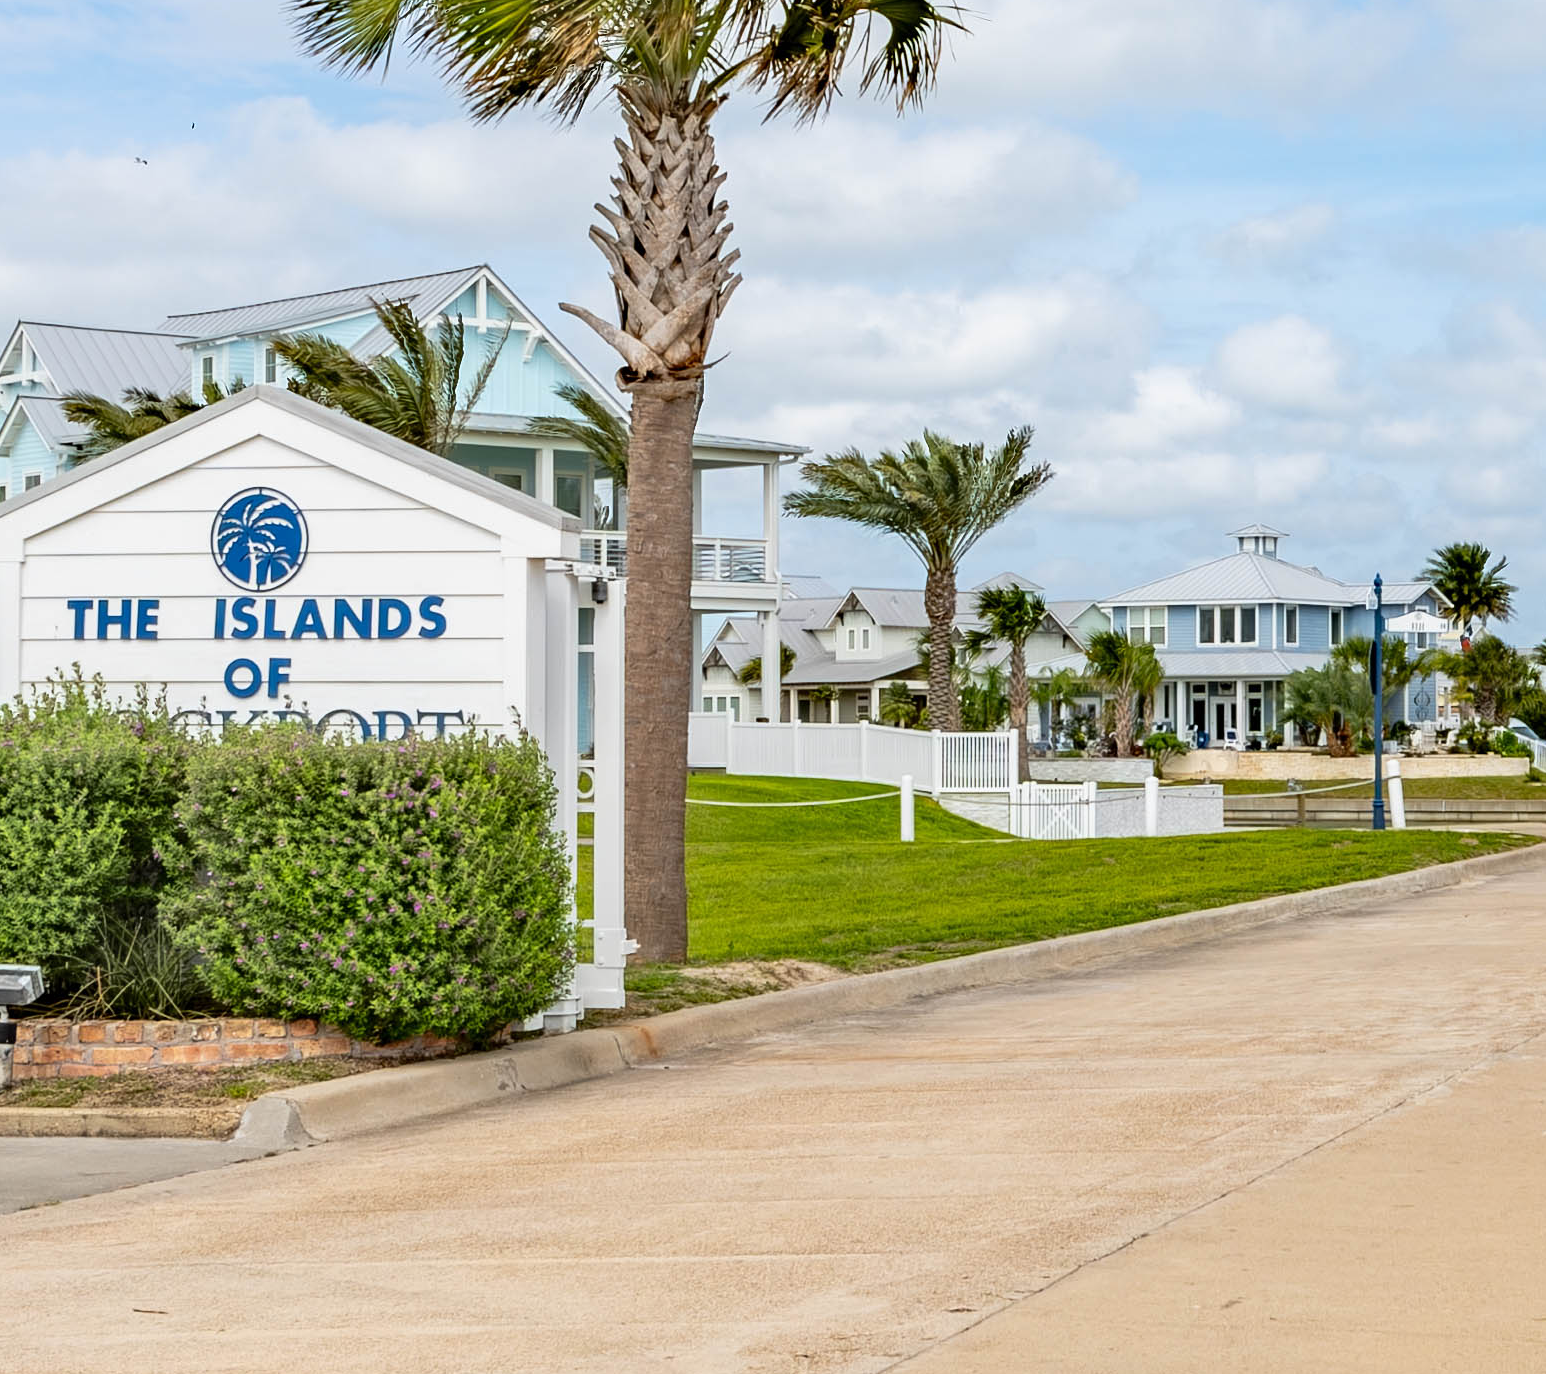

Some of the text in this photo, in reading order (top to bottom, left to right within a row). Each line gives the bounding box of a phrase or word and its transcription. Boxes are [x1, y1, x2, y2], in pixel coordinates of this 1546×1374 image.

[66, 595, 447, 640] THE ISLANDS
[223, 657, 292, 699] OF
